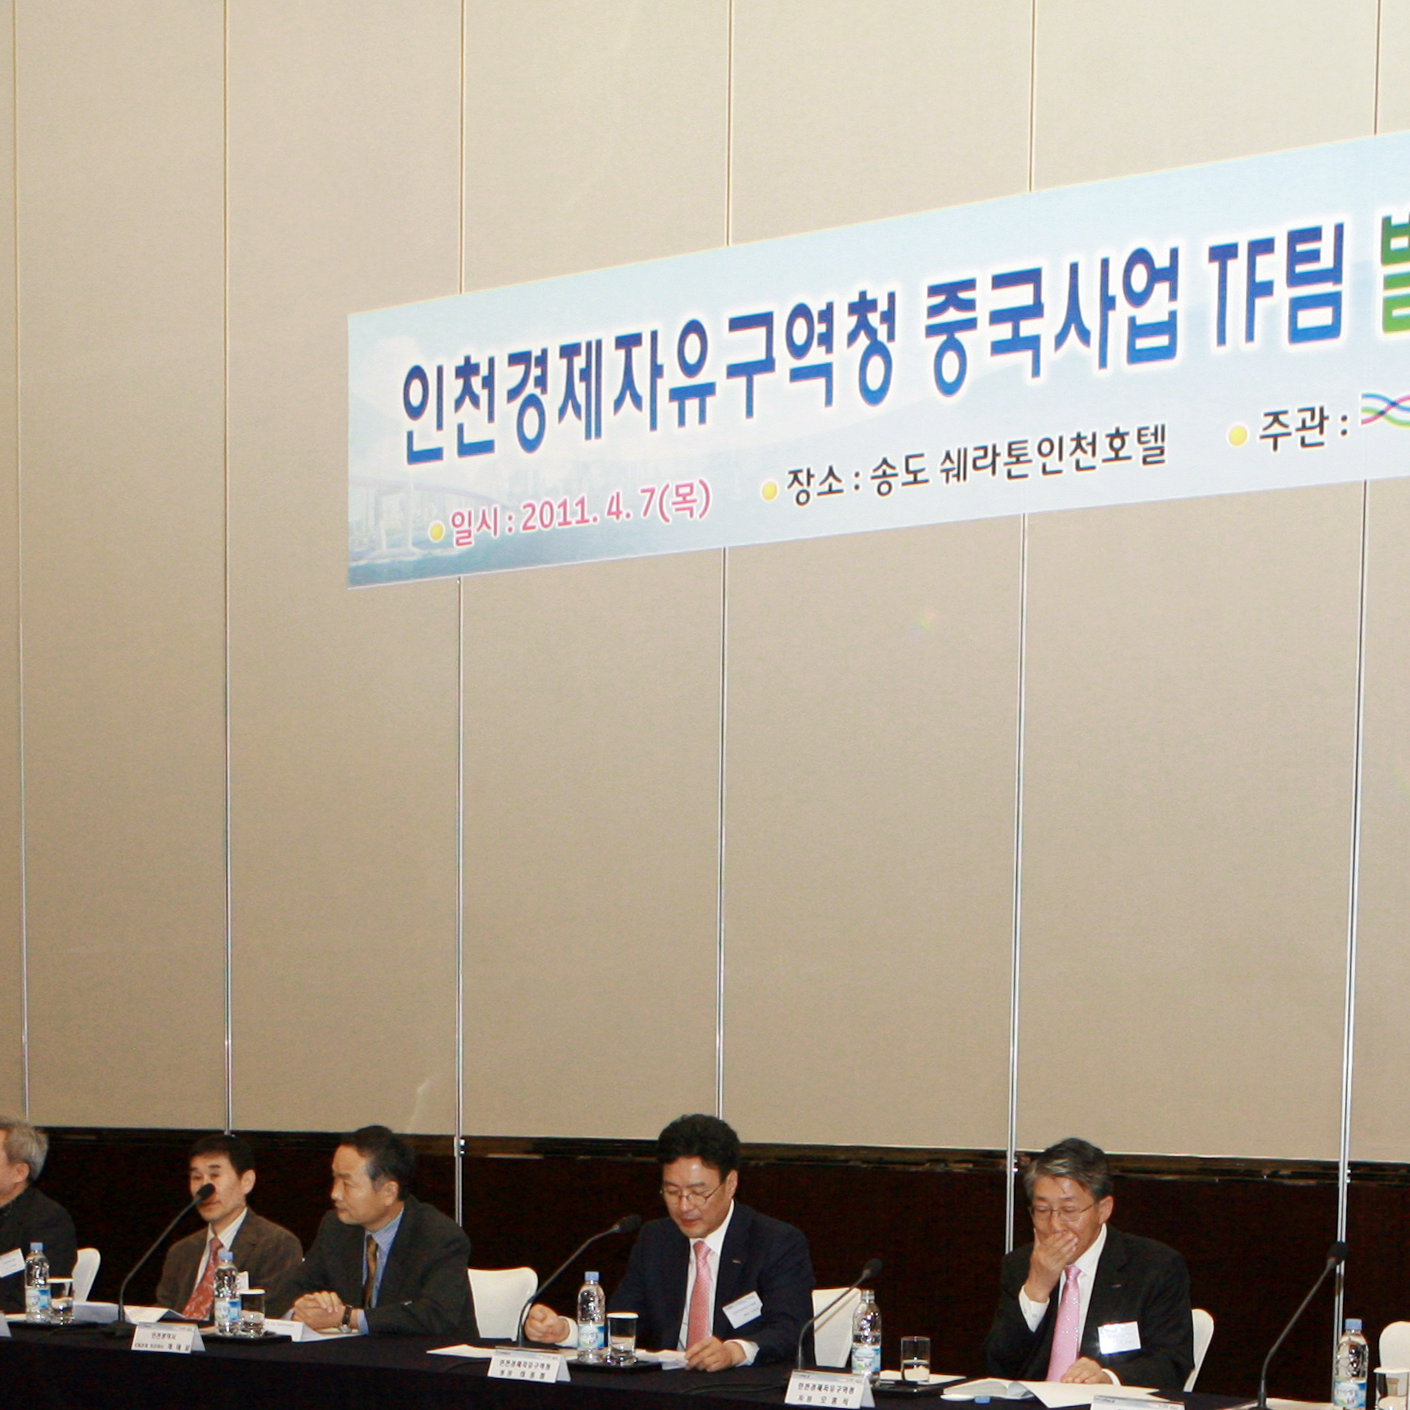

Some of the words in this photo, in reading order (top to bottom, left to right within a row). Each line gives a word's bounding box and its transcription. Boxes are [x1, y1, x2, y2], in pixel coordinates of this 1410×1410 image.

[402, 288, 898, 465] 인천경제자유구역청
[926, 245, 1179, 398] 중국사업
[1208, 222, 1346, 348] TF팀
[870, 452, 930, 497] 송도
[940, 424, 1167, 484] 쉐라톤인천호텔
[641, 479, 712, 524] 7(목)
